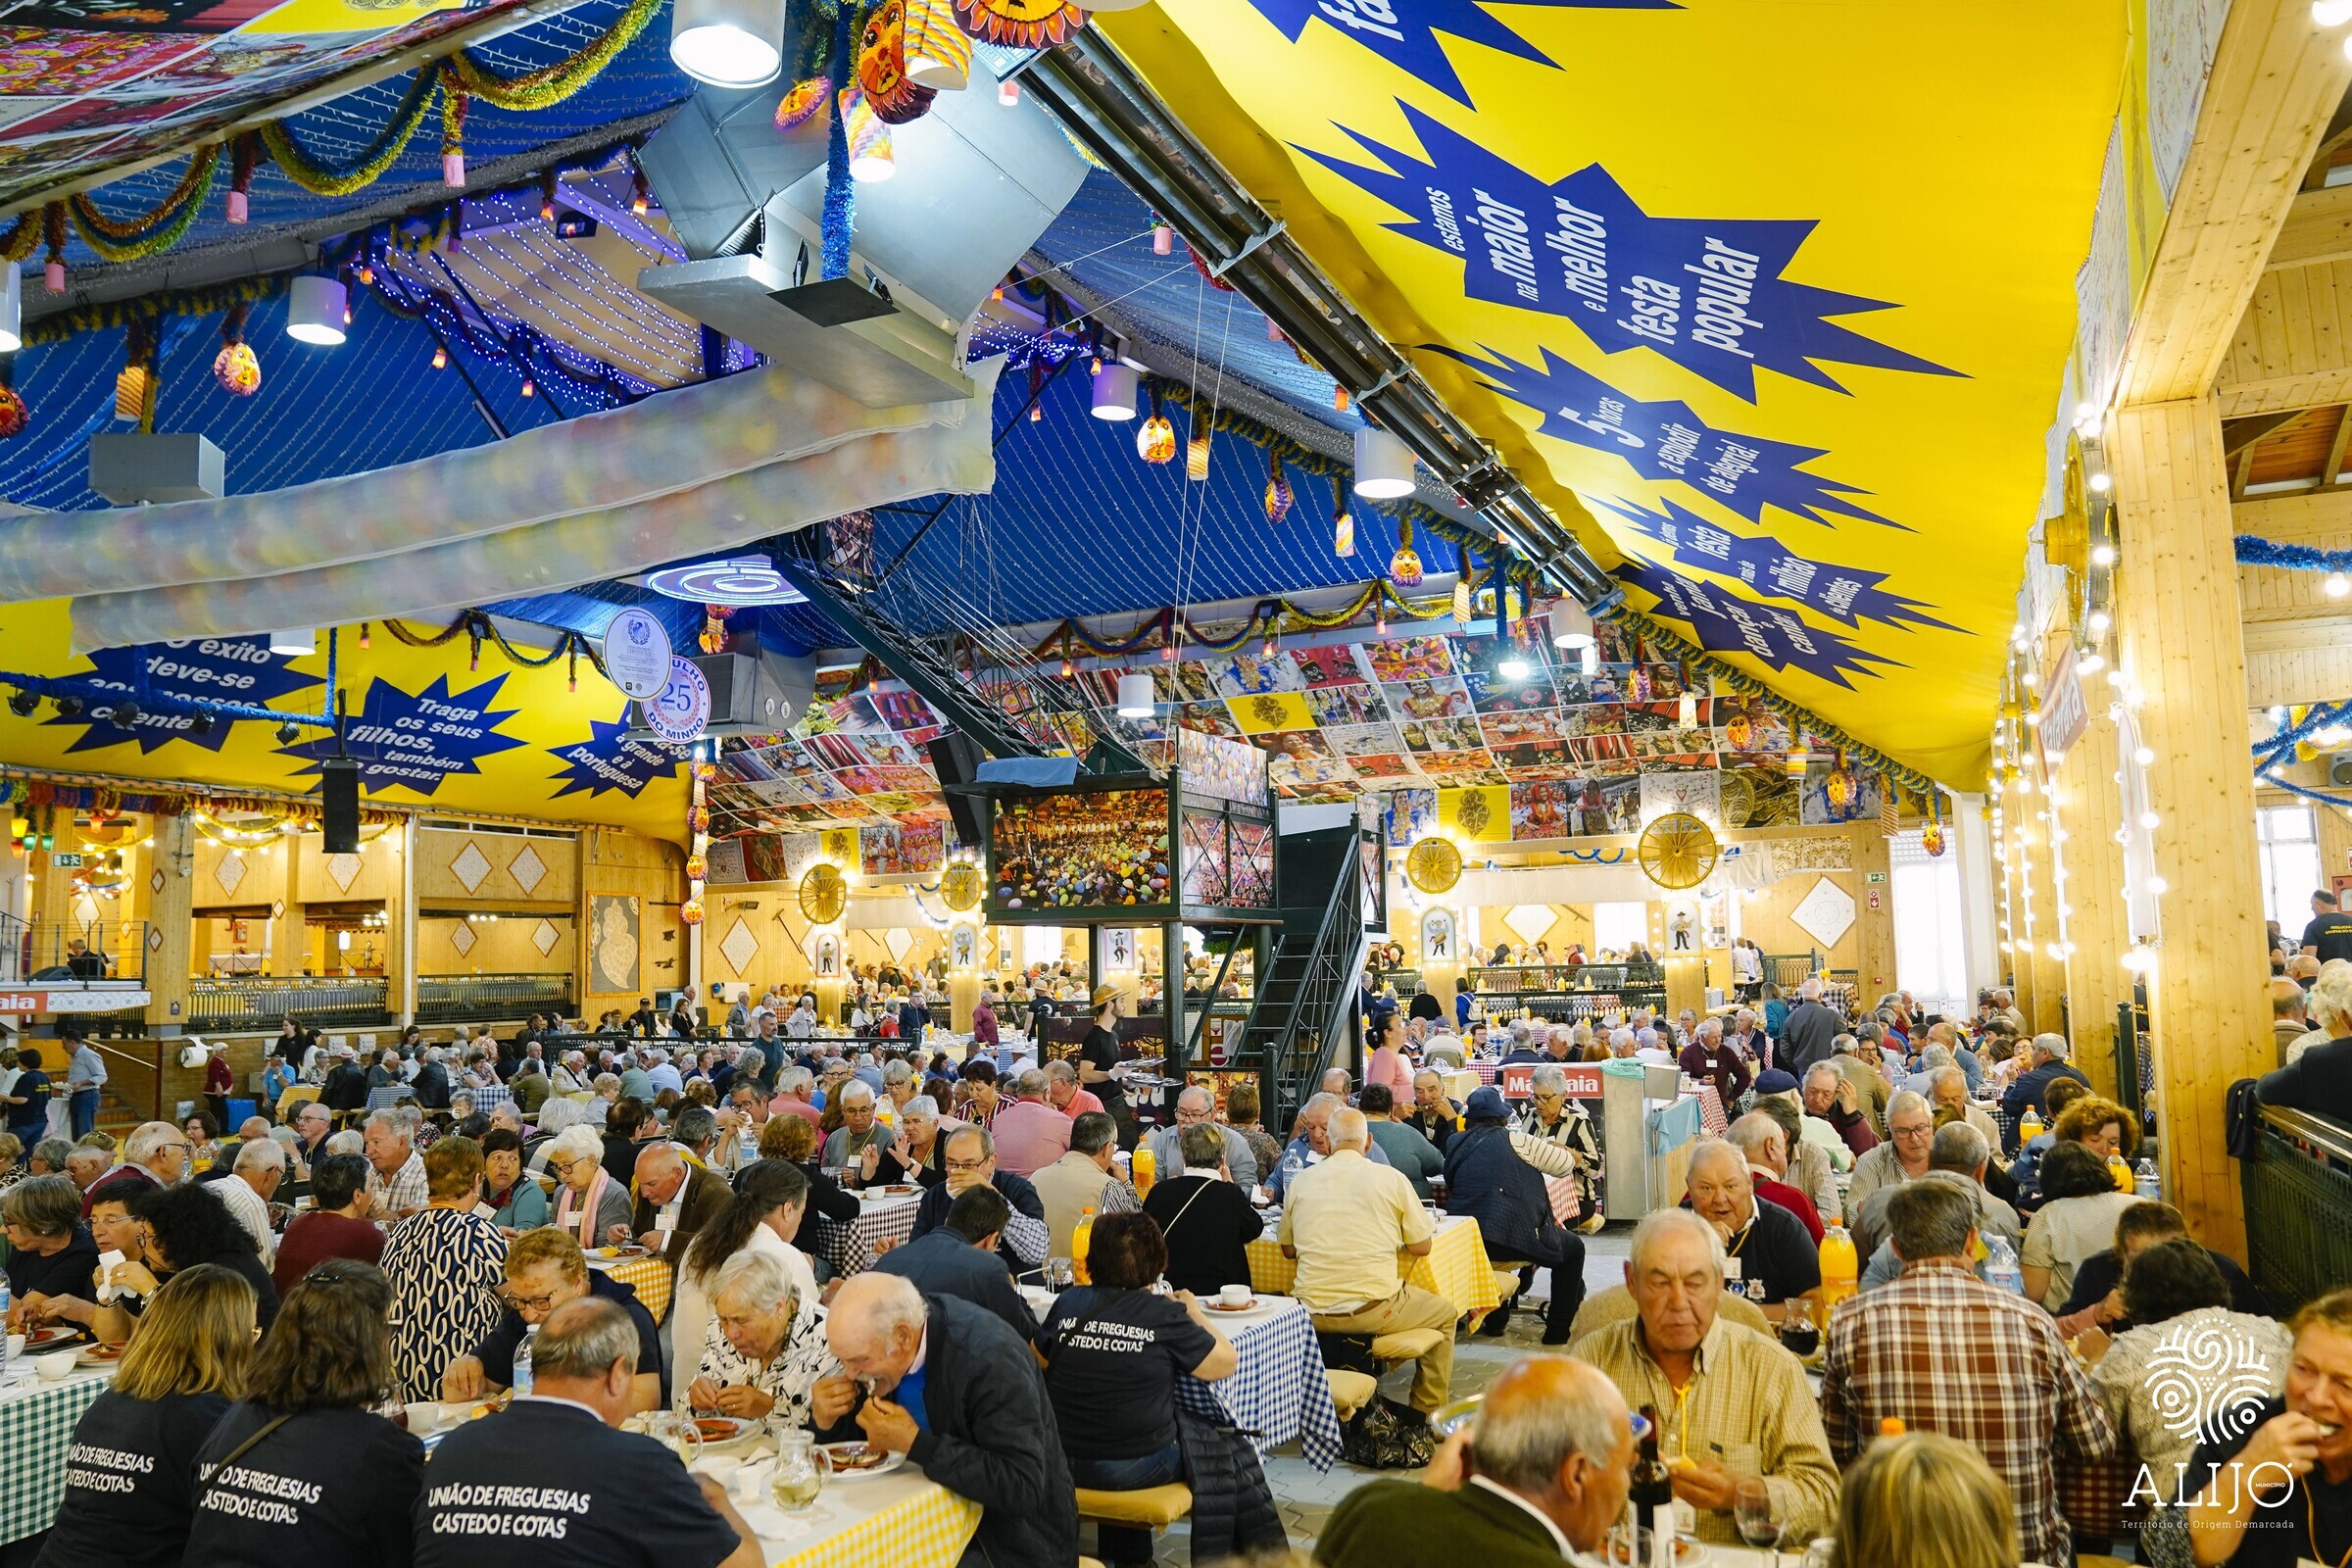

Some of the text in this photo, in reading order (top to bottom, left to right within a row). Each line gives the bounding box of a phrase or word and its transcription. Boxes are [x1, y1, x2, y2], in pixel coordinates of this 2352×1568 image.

[1425, 186, 1466, 252] estamos
[1465, 187, 1539, 302] na maior
[1544, 195, 1608, 313] e melhor
[1616, 274, 1683, 346] festa
[1683, 236, 1765, 359] popular
[1557, 396, 1645, 448] 5 horas
[1656, 422, 1702, 475] a explodir
[1699, 438, 1761, 495] de alegria!
[1686, 524, 1732, 562] festa
[1768, 556, 1818, 600] 1 milhão
[1661, 580, 1691, 616] venha
[1670, 572, 1729, 620] jantar
[1819, 576, 1863, 616] de clientes
[1719, 600, 1776, 658] dançar
[1760, 620, 1776, 629] e
[416, 698, 479, 721] Traga
[661, 682, 691, 711] 25
[346, 725, 436, 753] filhos,
[395, 716, 483, 739] os seus
[648, 711, 704, 740] DO MINHO
[383, 750, 465, 770] também
[566, 746, 644, 790] portuguesa
[612, 755, 624, 764] e
[620, 740, 665, 766] grande
[365, 763, 443, 781] gostar.
[1509, 1074, 1599, 1094] Maaia
[1059, 1332, 1145, 1352] CSTEDO E COTAS
[1083, 1320, 1099, 1334] DE
[1098, 1321, 1155, 1343] FREGUESIAS
[84, 1446, 97, 1464] DE
[93, 1447, 155, 1473] FREGUESIAS
[89, 1472, 97, 1489] E
[95, 1474, 135, 1493] COTAS
[230, 1467, 250, 1489] DE
[246, 1471, 322, 1504] FREGUESIAS
[247, 1498, 259, 1518] E
[256, 1500, 299, 1524] COTAS
[427, 1482, 592, 1514] UNIÃO DE FREGUESIAS
[432, 1513, 568, 1540] CASTEDO E COTAS
